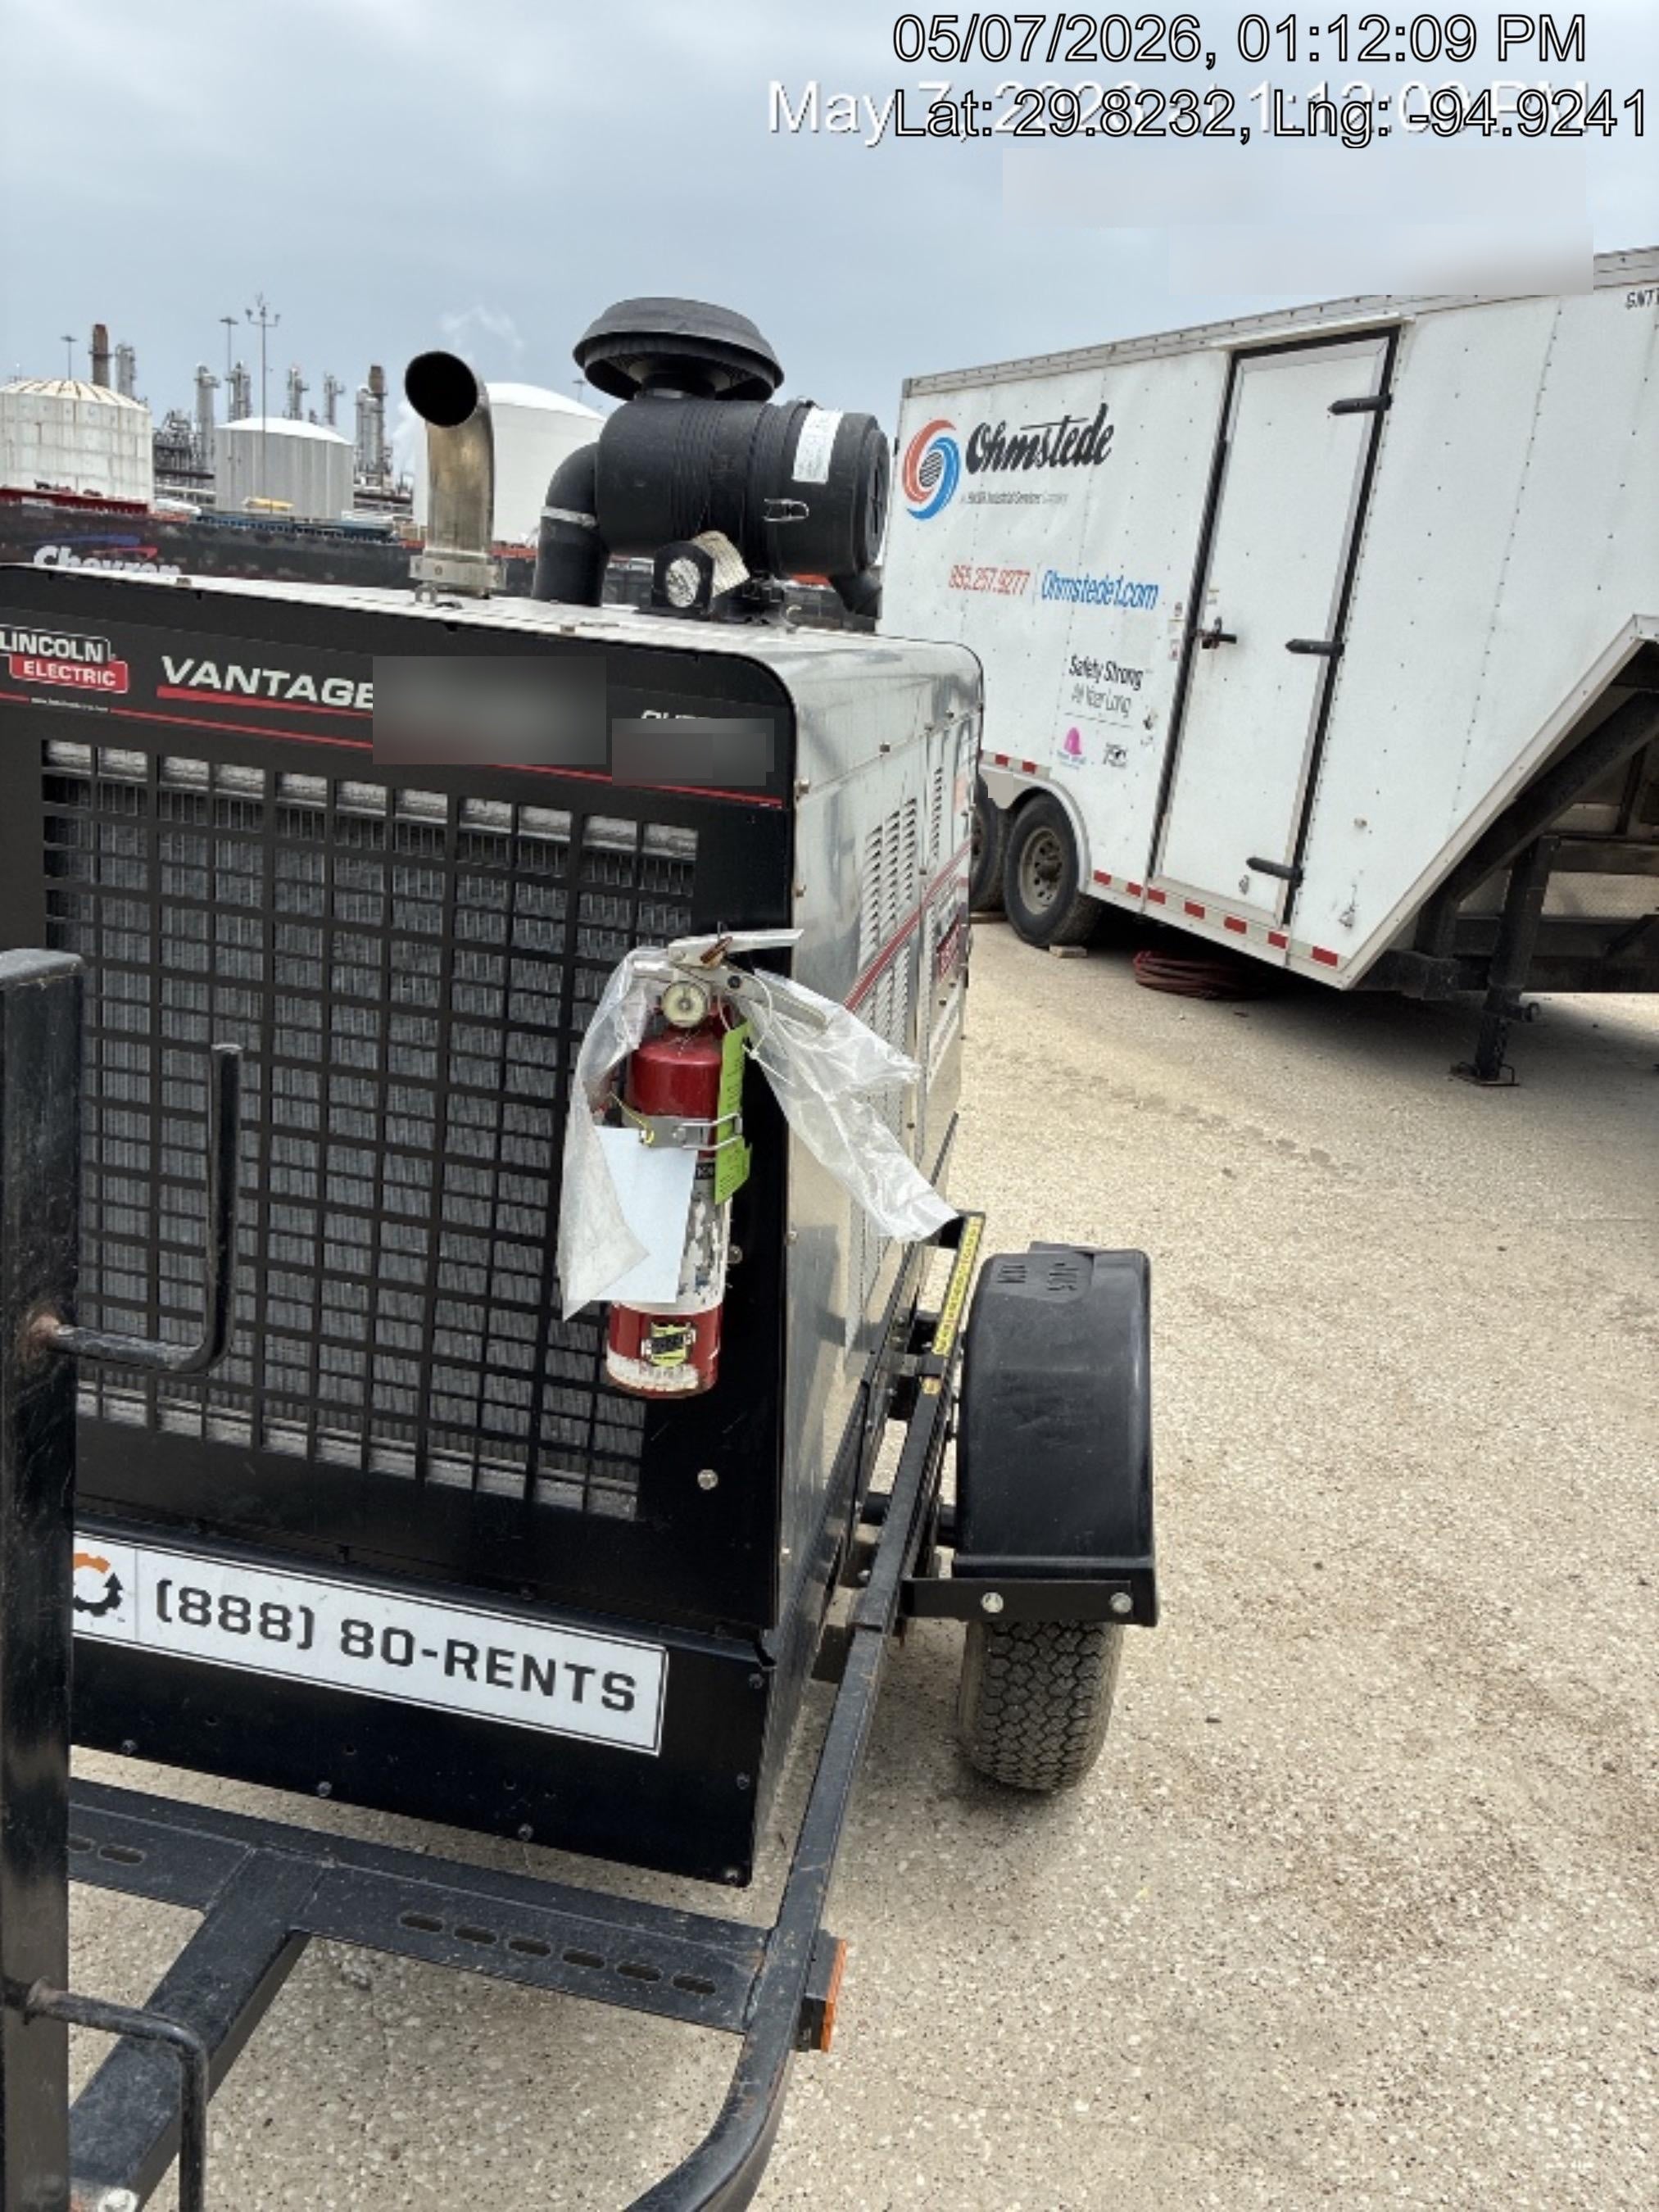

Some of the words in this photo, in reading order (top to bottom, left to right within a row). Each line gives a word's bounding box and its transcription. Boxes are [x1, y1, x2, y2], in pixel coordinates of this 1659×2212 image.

[966, 402, 1114, 474] Ohmstede
[1041, 569, 1159, 610] Ohmstede1.com
[0, 631, 103, 664] LINCOLN
[24, 660, 116, 687] ELECTRIC
[161, 655, 373, 709] VANTAGE
[1068, 654, 1101, 684] Safety
[1104, 660, 1144, 691] Strong
[156, 1579, 315, 1650] (888)
[339, 1618, 637, 1712] 80-RENTS
